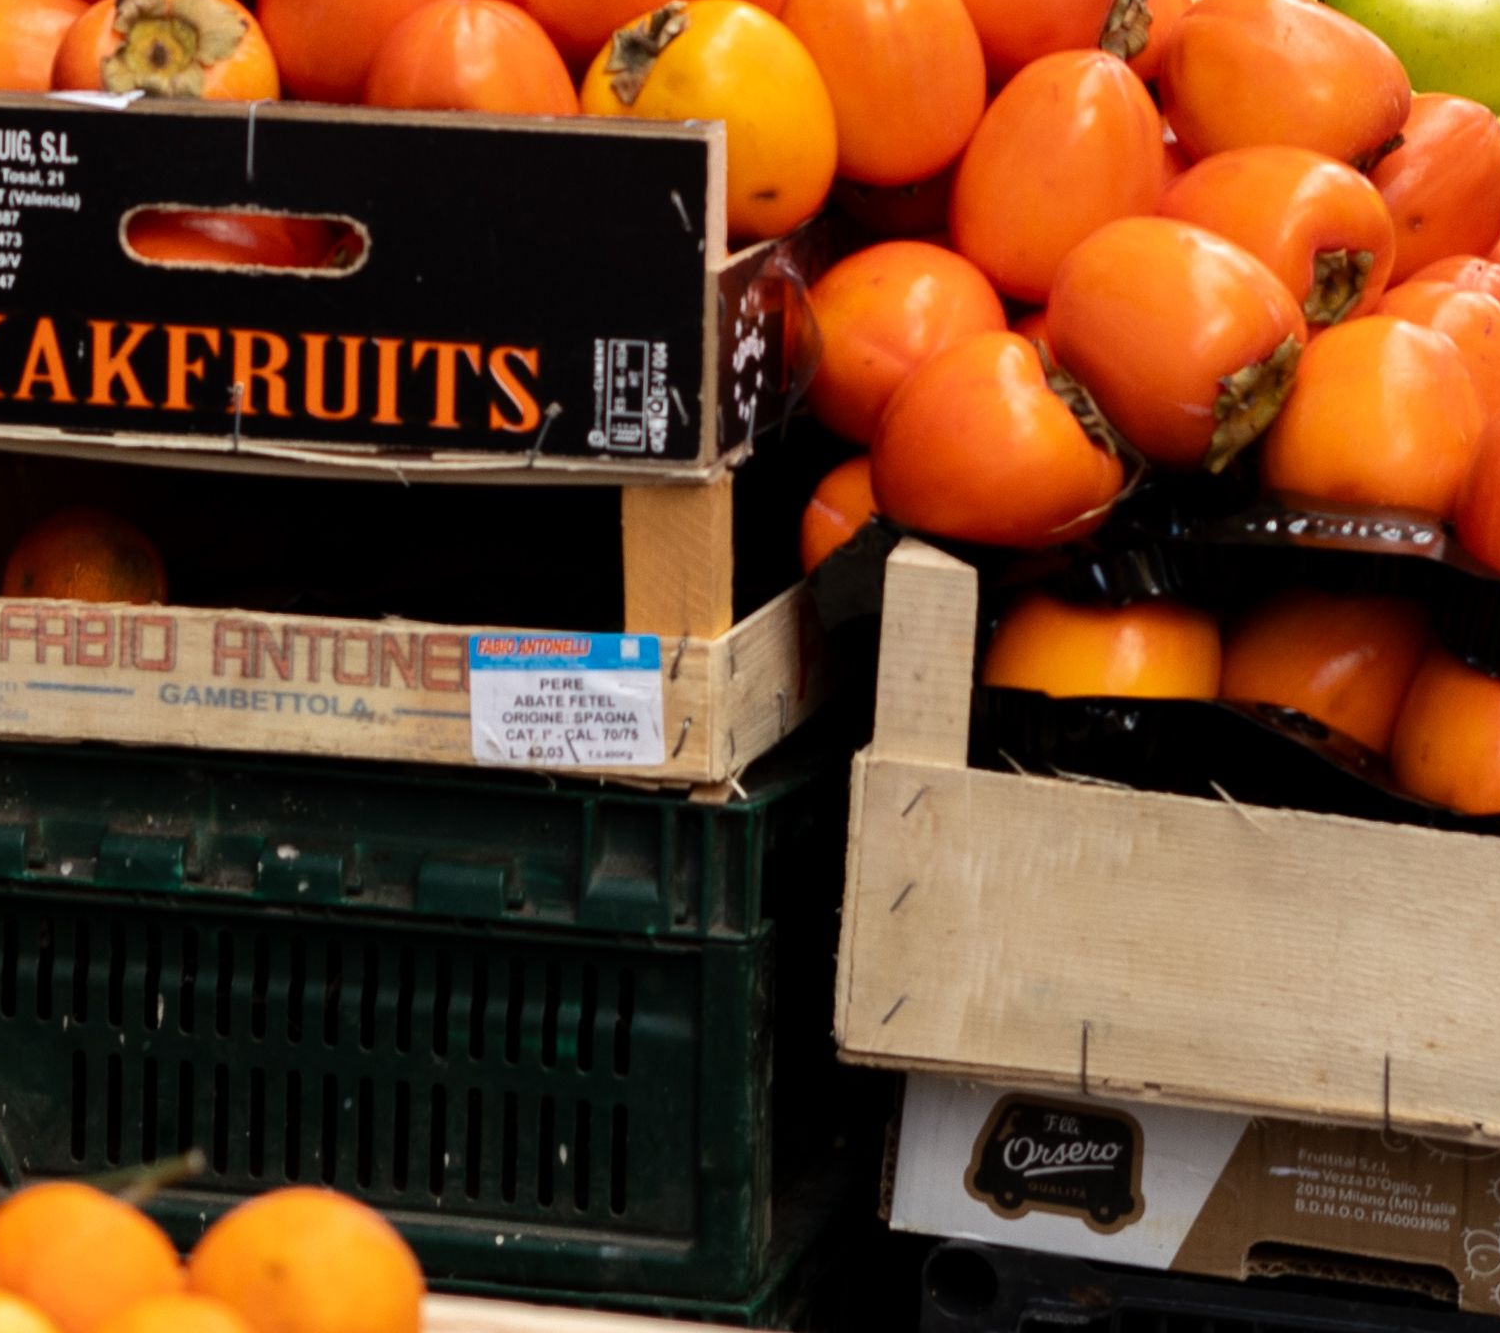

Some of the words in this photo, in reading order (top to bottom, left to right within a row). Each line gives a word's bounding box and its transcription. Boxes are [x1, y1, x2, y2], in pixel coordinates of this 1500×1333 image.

[41, 131, 78, 164] S.L.
[2, 168, 44, 186] Tosal,
[47, 171, 65, 186] 21
[8, 190, 81, 212] (Valencia)
[0, 604, 177, 672] FABIO
[212, 617, 470, 693] ANTONE
[477, 638, 515, 656] FABIO
[519, 638, 592, 656] ANTONELLI
[540, 677, 584, 691] PERE
[159, 682, 372, 720] GAMBETTOLA
[514, 695, 565, 708] ABATE
[569, 695, 616, 708] FETEL
[573, 711, 638, 724] SPAGNA
[603, 728, 640, 742] 70/75
[1003, 1137, 1123, 1170] Orsero
[1299, 1148, 1356, 1167] Fruttital
[1322, 1169, 1363, 1187] Vezza
[1366, 1176, 1421, 1197] D'Oglio,
[1424, 1184, 1433, 1198] 7
[1296, 1182, 1336, 1199] 20139
[1338, 1188, 1385, 1207] Milano
[1388, 1197, 1418, 1213] (MI)
[1422, 1201, 1457, 1216] Italia
